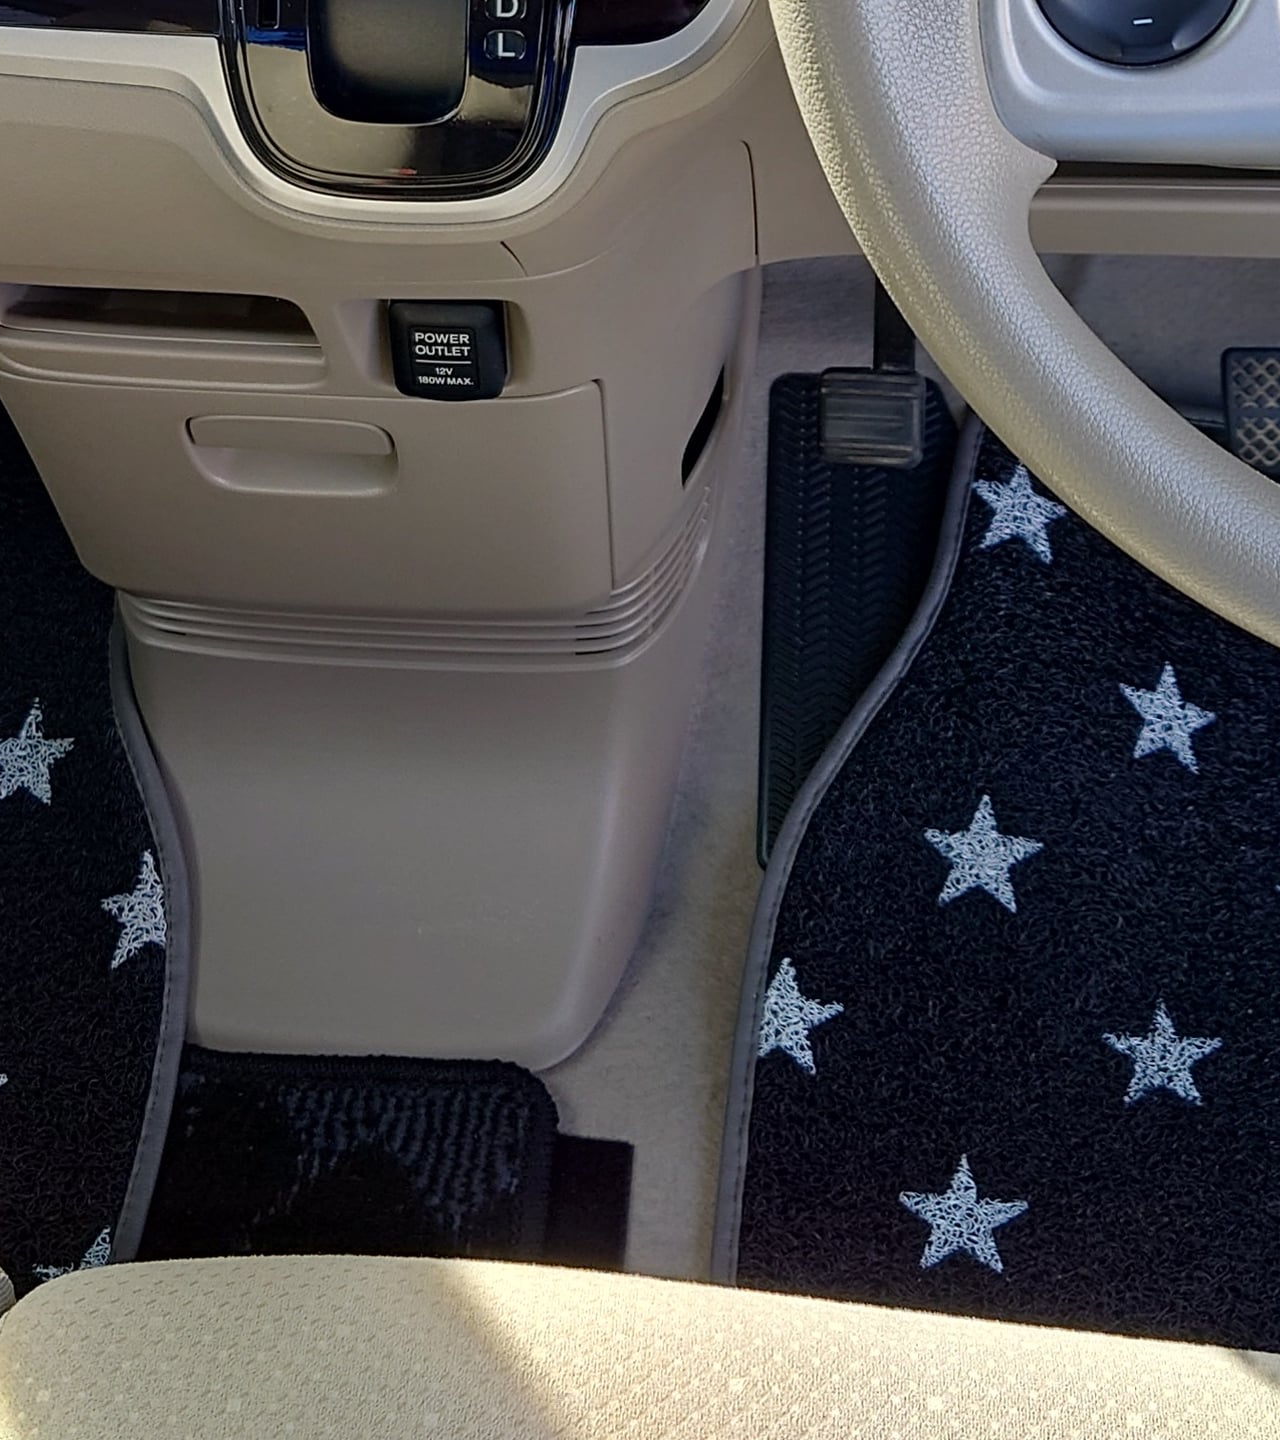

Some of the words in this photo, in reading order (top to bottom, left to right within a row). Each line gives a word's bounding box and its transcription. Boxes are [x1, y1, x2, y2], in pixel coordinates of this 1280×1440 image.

[497, 33, 516, 58] L
[414, 332, 470, 345] POWER
[415, 345, 472, 357] OUTLET
[435, 367, 454, 376] 12V
[417, 376, 446, 385] 180W
[446, 377, 475, 386] MAX.
